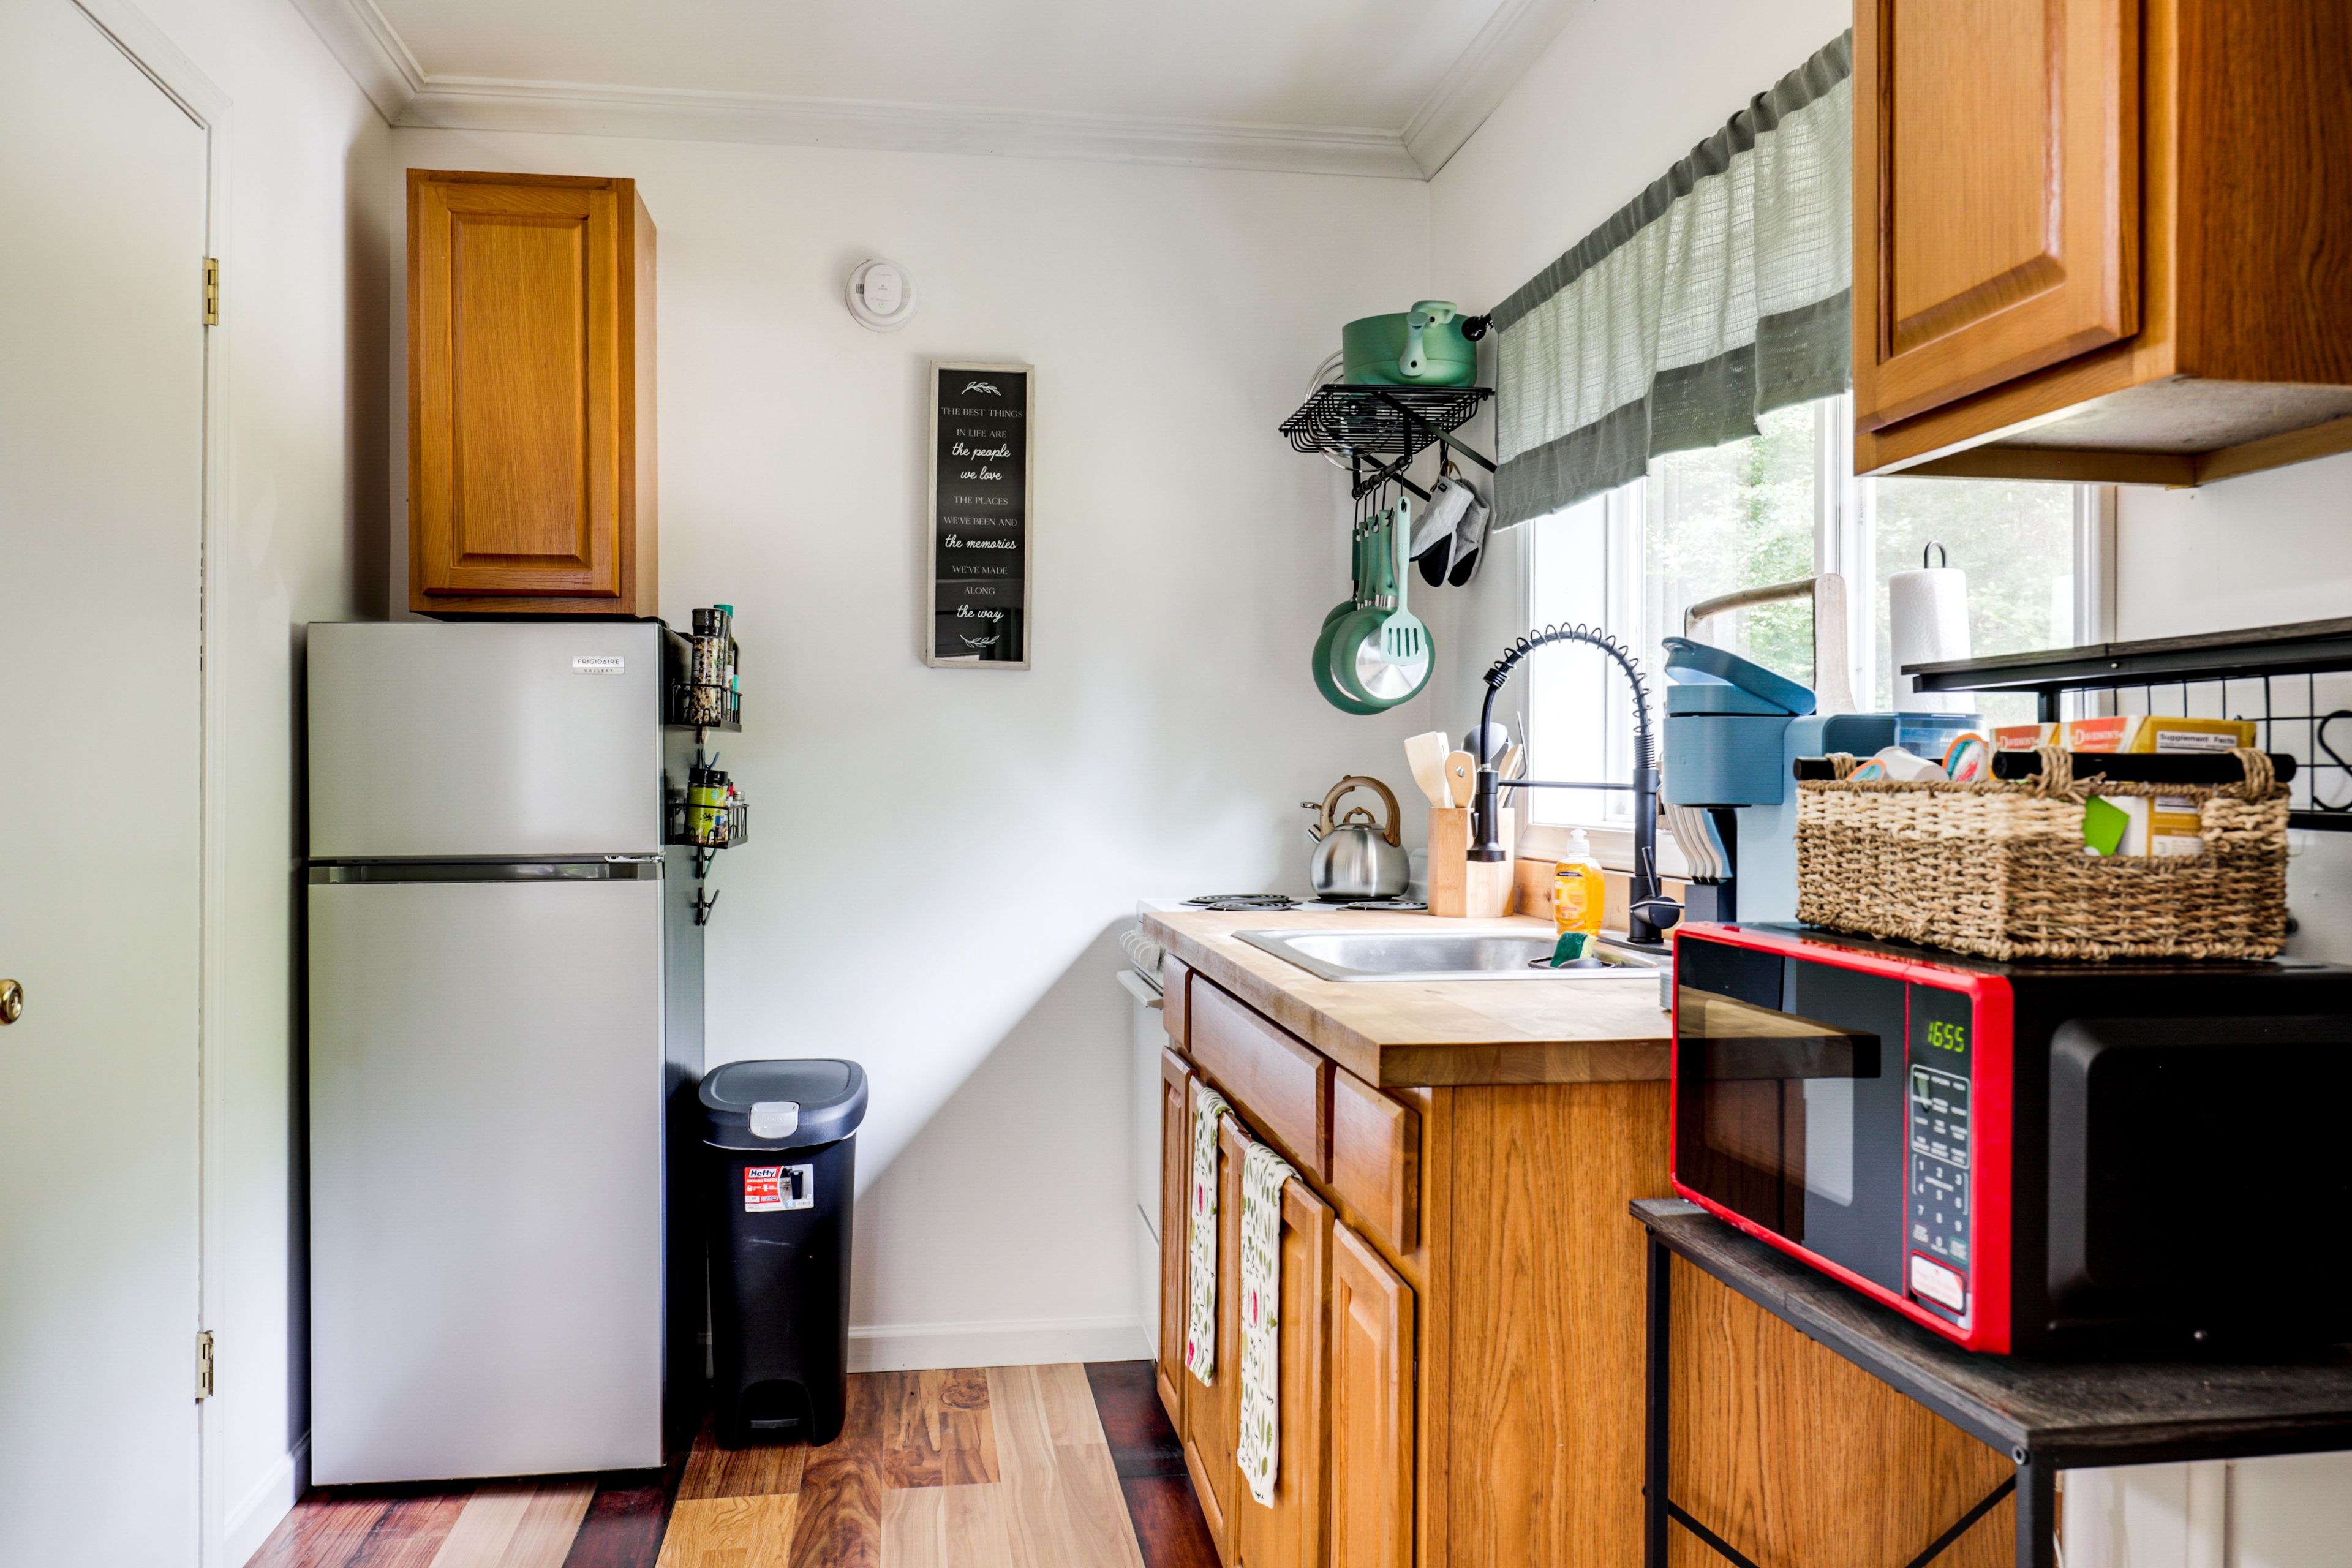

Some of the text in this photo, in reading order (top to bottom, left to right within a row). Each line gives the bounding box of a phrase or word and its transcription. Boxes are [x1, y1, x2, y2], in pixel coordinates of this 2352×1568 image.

[941, 407, 1023, 418] THE BEST THINGS
[952, 442, 1011, 461] the people
[979, 466, 1003, 480] love
[975, 497, 1009, 505] PLACES
[945, 534, 1017, 549] the memories
[957, 604, 1004, 623] the way
[1936, 1167, 1943, 1178] 2
